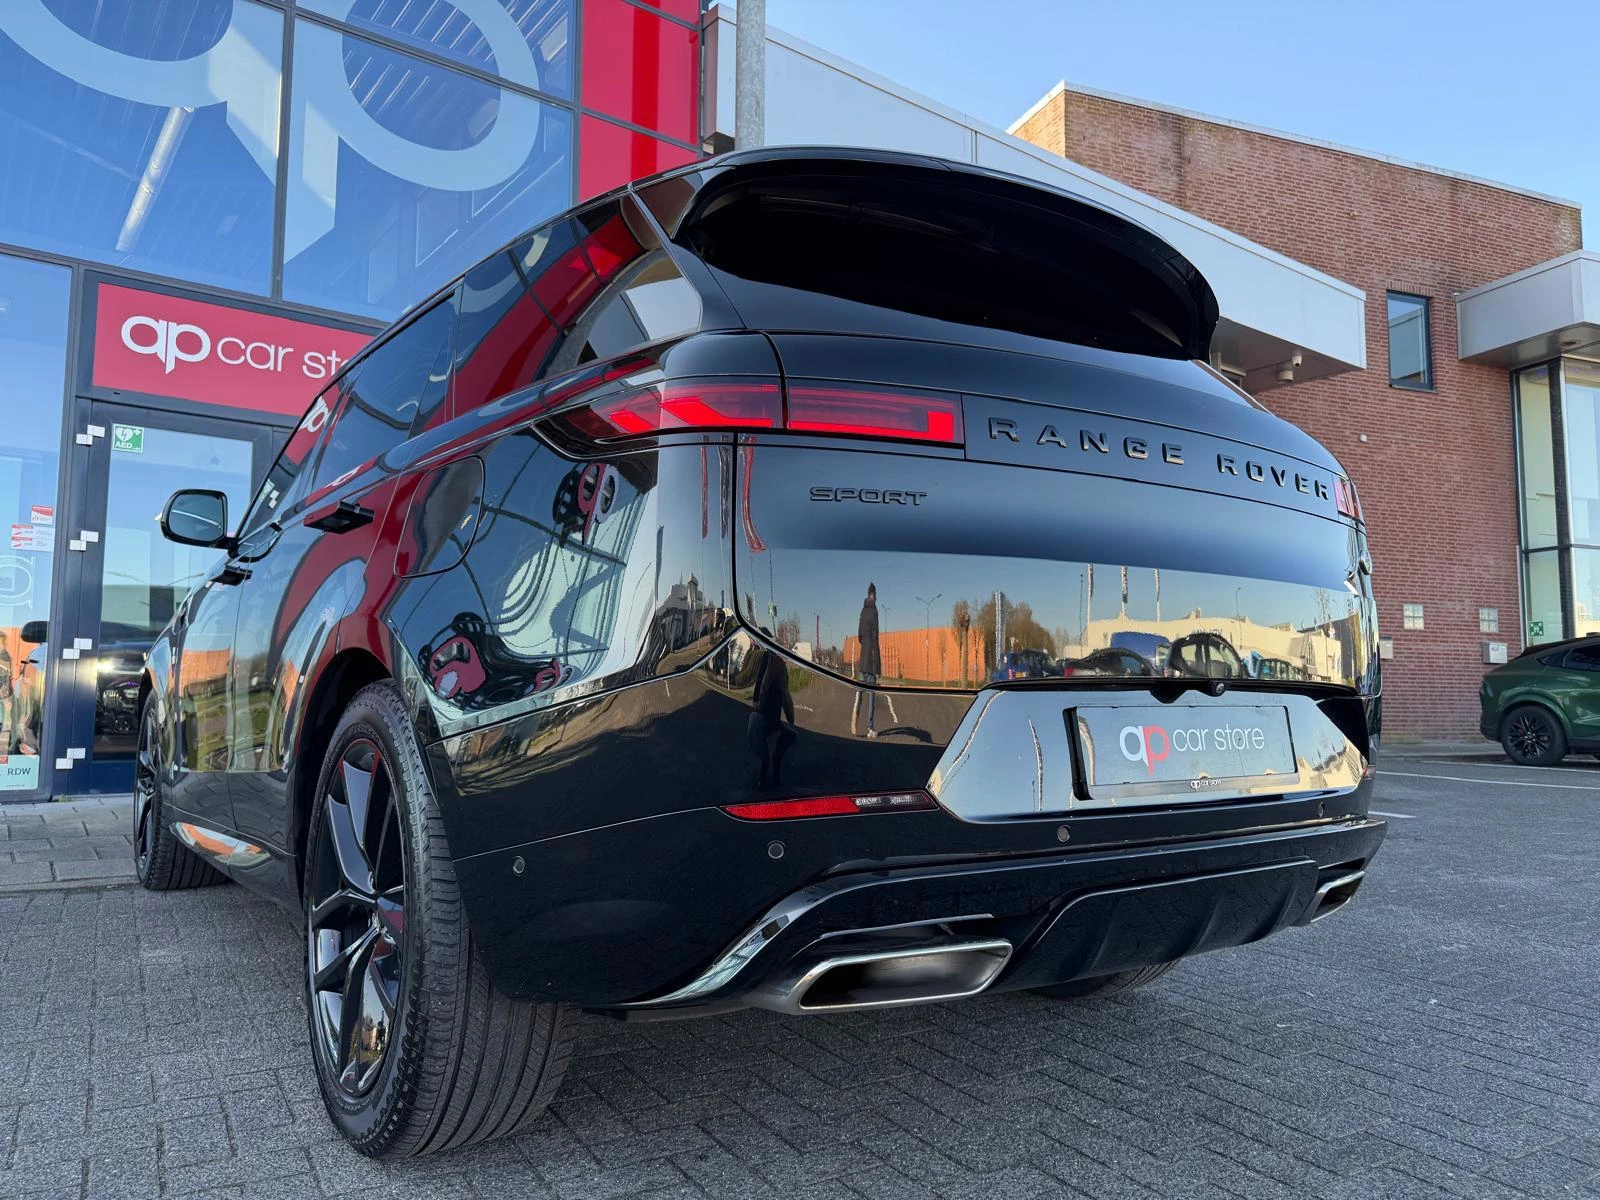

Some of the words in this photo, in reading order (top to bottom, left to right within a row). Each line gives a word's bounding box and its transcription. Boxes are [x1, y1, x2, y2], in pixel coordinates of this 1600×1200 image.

[120, 315, 211, 375] ap
[216, 337, 294, 372] car
[115, 440, 133, 449] AED
[988, 416, 1185, 466] RANGE
[1216, 452, 1328, 500] ROVER
[809, 486, 928, 506] SPORT
[1119, 725, 1171, 777] ap
[1172, 728, 1209, 751] car
[1214, 723, 1265, 751] store
[7, 767, 31, 776] RDW
